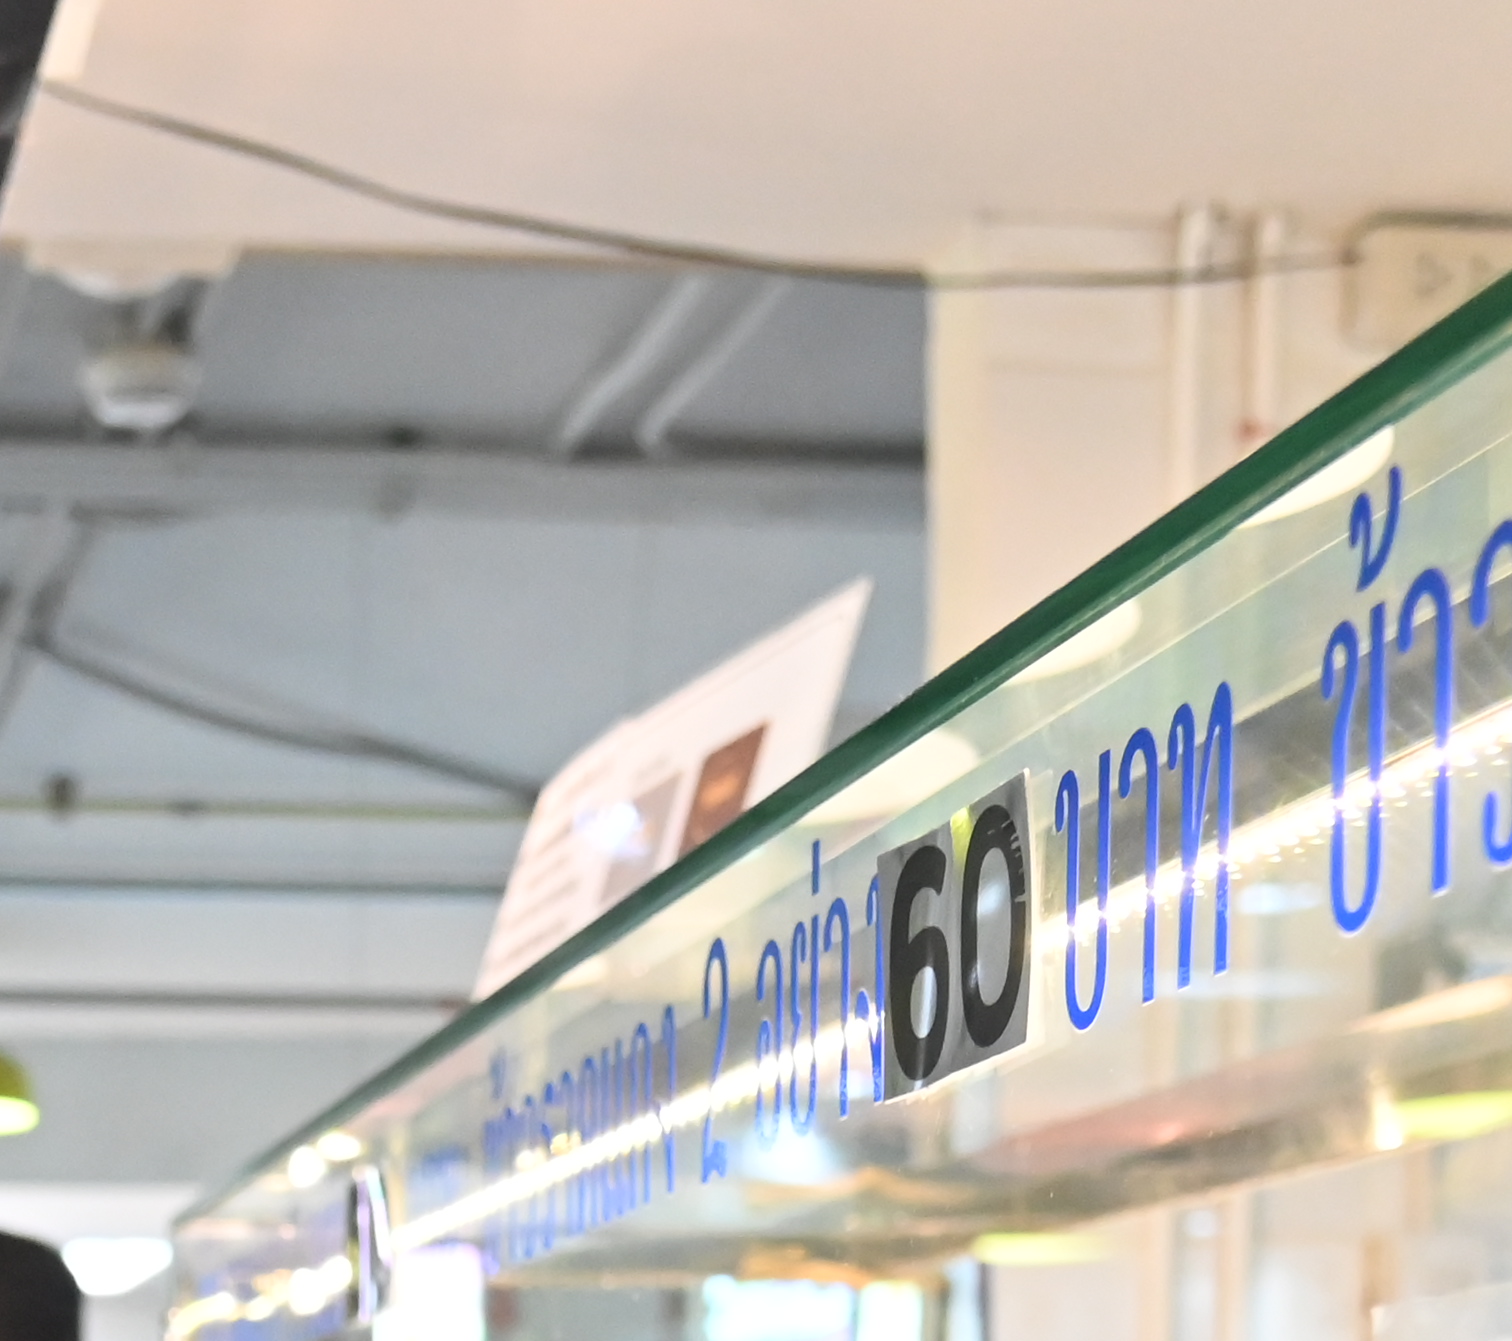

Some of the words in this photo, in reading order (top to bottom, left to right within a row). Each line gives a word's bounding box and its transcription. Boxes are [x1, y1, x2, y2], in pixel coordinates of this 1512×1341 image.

[702, 938, 730, 1184] 2
[890, 801, 1029, 1084] 60
[1053, 681, 1235, 1032] บาท
